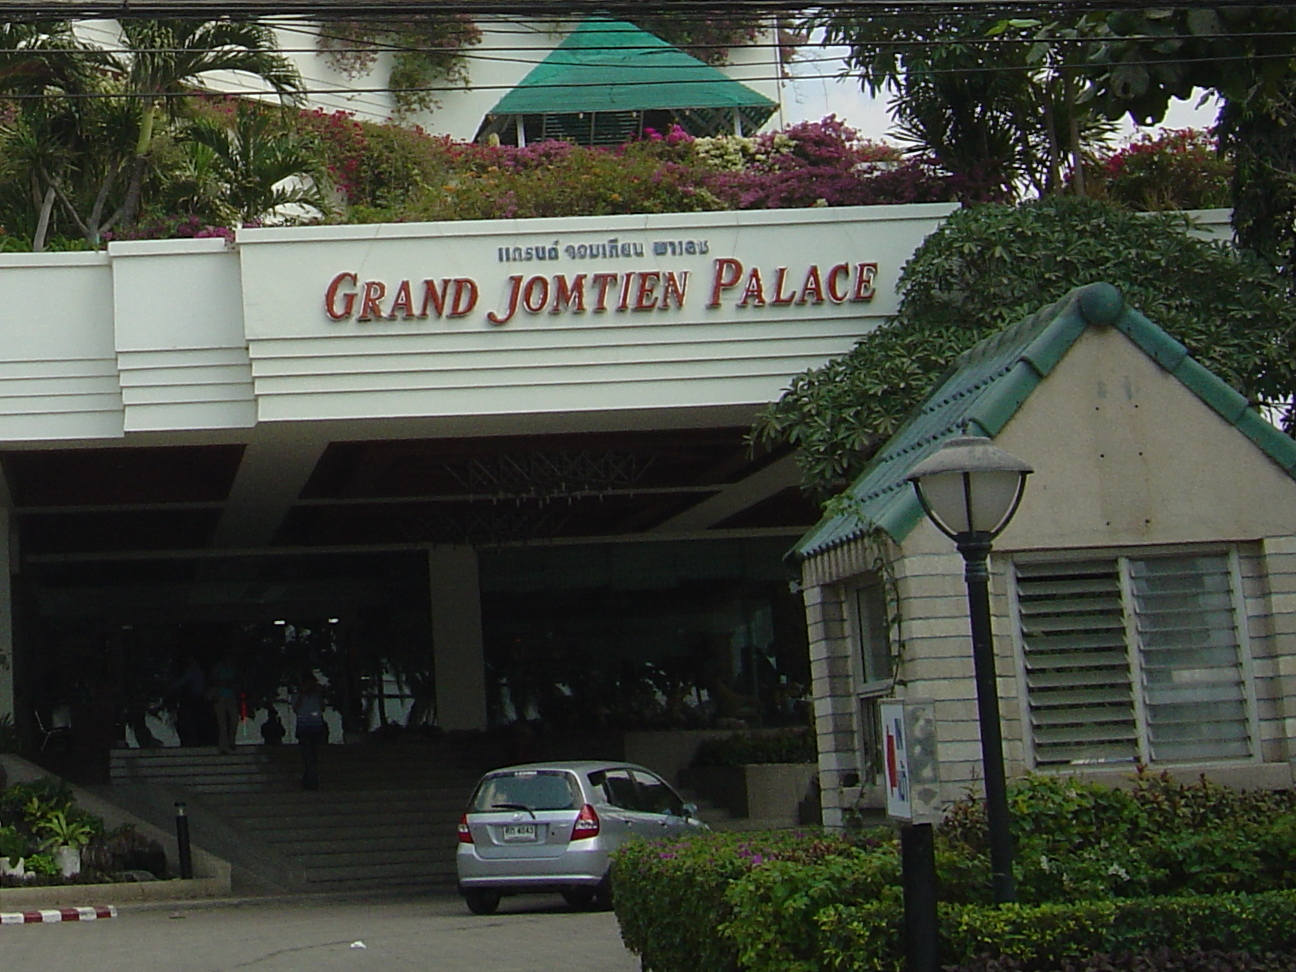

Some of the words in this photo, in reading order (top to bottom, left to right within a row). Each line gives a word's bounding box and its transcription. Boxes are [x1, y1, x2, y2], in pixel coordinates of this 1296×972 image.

[325, 271, 479, 322] GRAND
[486, 270, 692, 325] JOMTIEN
[706, 256, 878, 310] PALACE
